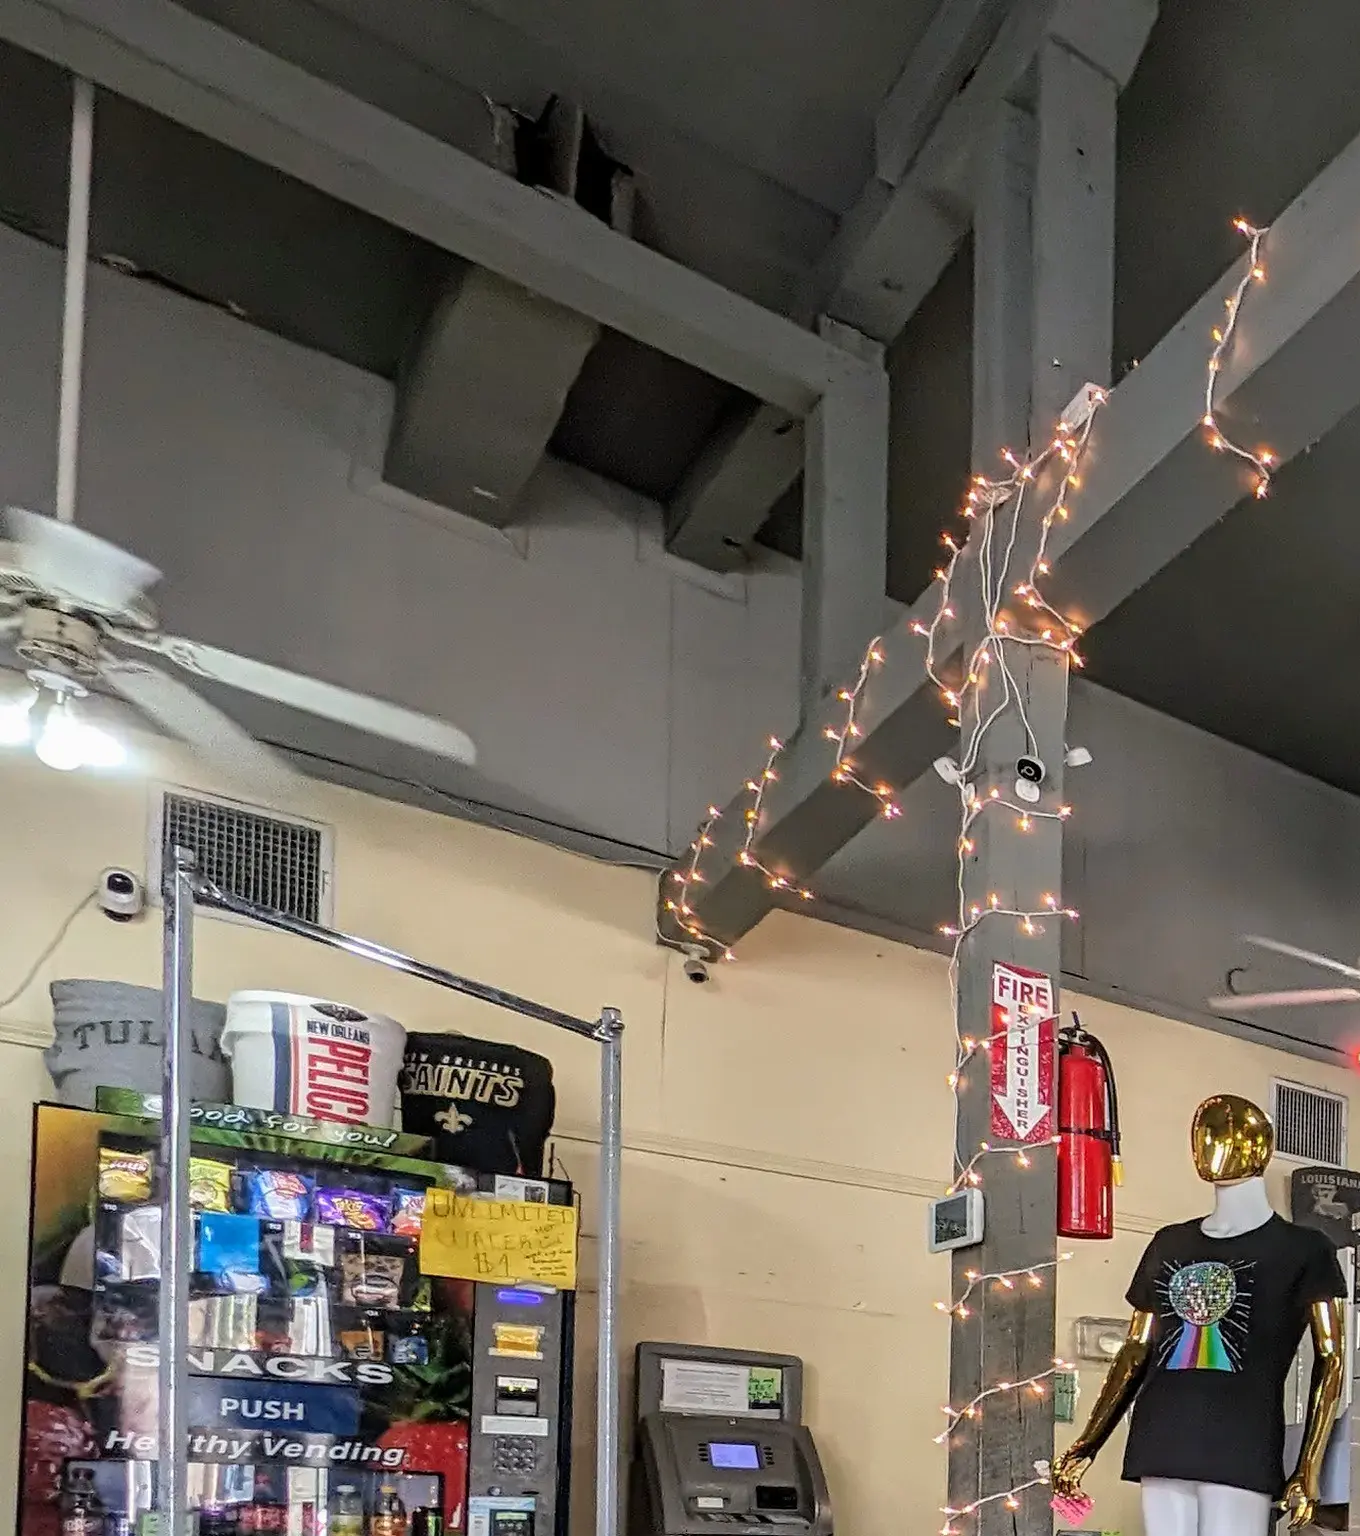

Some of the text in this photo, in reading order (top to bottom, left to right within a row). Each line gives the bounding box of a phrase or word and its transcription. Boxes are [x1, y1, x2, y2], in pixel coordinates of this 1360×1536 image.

[998, 975, 1048, 1010] FIRE
[307, 1020, 370, 1043] NEW ORLEANS
[1016, 1004, 1030, 1129] EXTINGUISHER
[401, 1063, 524, 1107] SAINTS
[262, 1115, 318, 1134] for
[334, 1130, 398, 1148] you!
[126, 1348, 394, 1385] SNACKS
[220, 1397, 305, 1421] PUSH
[105, 1430, 403, 1464] Hethy Vending
